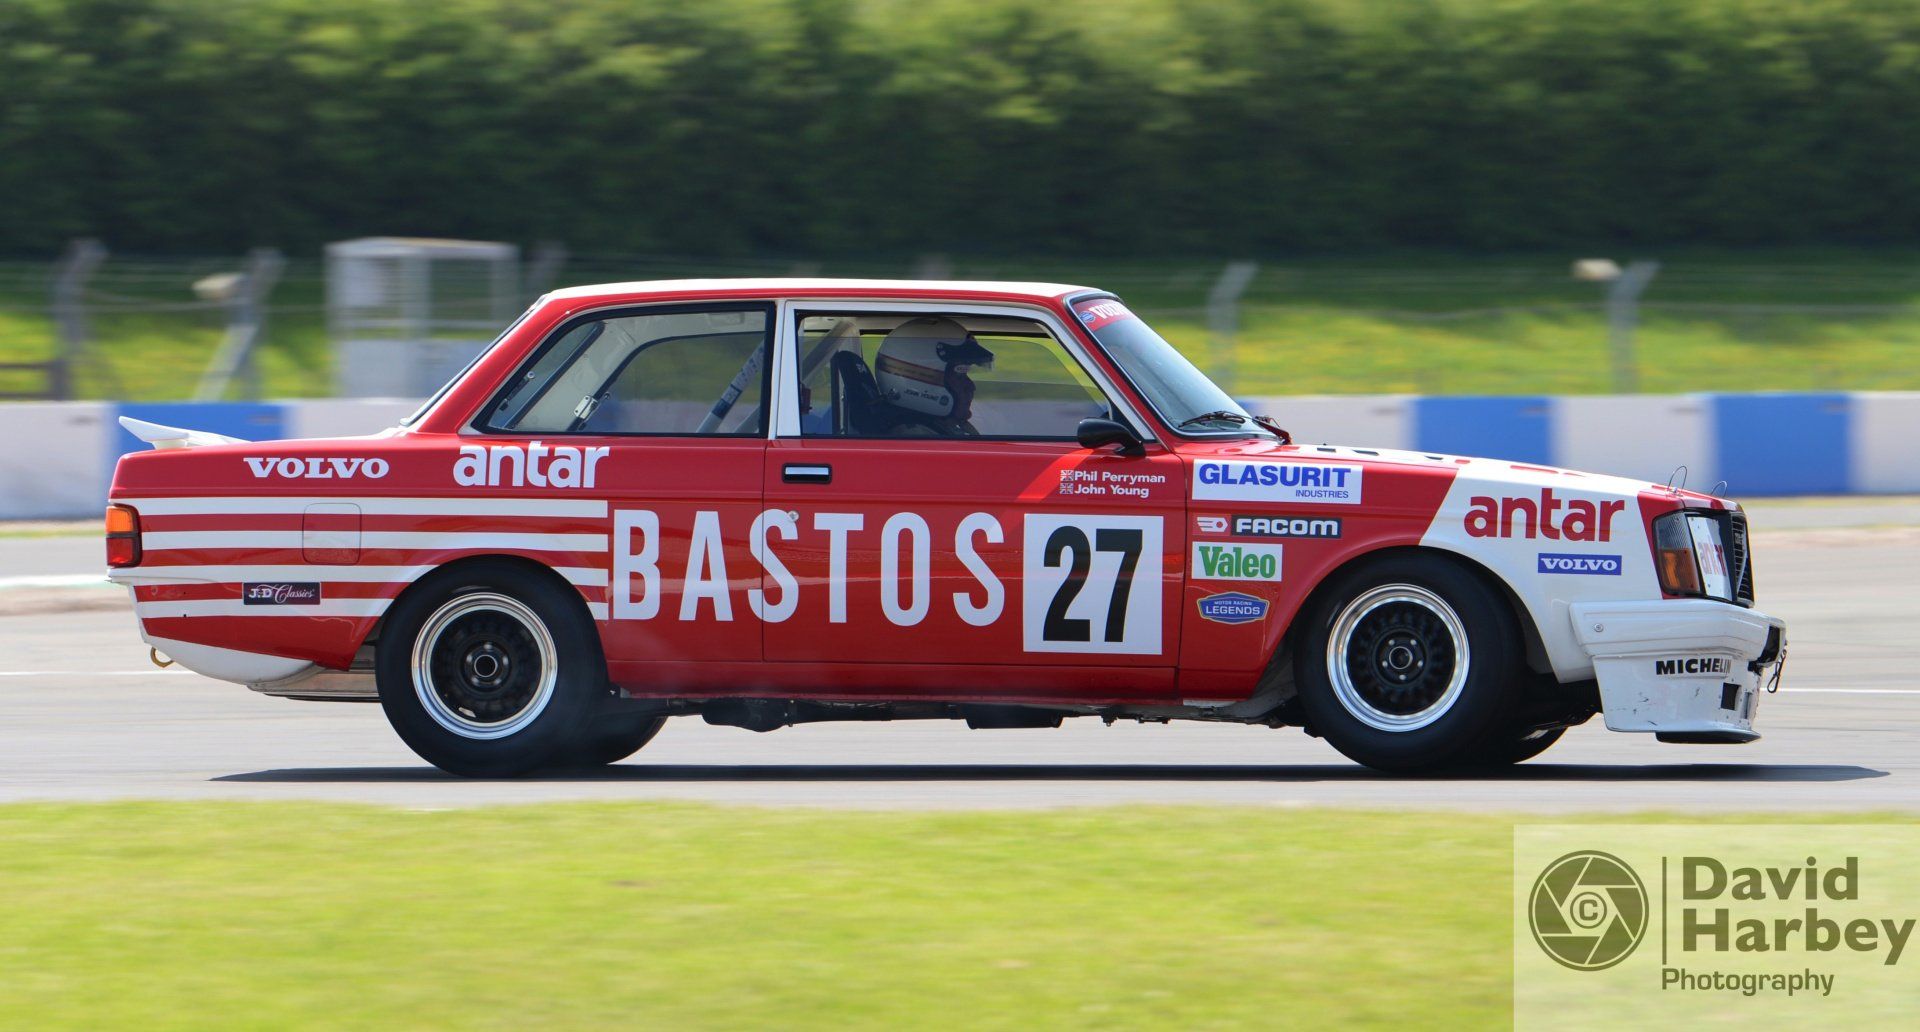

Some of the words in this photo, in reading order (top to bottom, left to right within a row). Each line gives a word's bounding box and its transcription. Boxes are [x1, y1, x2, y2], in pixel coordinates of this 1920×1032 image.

[243, 457, 390, 478] VOLVO
[453, 441, 610, 488] antar
[1074, 470, 1098, 481] Phil
[1102, 471, 1166, 485] Perryman
[1199, 463, 1351, 488] GLASURIT
[1074, 484, 1106, 494] John
[1110, 485, 1149, 498] Young
[1295, 489, 1349, 499] INDUSTRIES
[1463, 488, 1625, 542] antar
[1236, 518, 1339, 536] FACOM
[613, 508, 1006, 627] BASTOS
[1199, 546, 1276, 578] Valeo
[1541, 557, 1618, 571] VOLVO
[1043, 525, 1144, 642] 27
[1206, 605, 1260, 615] LEGENDS
